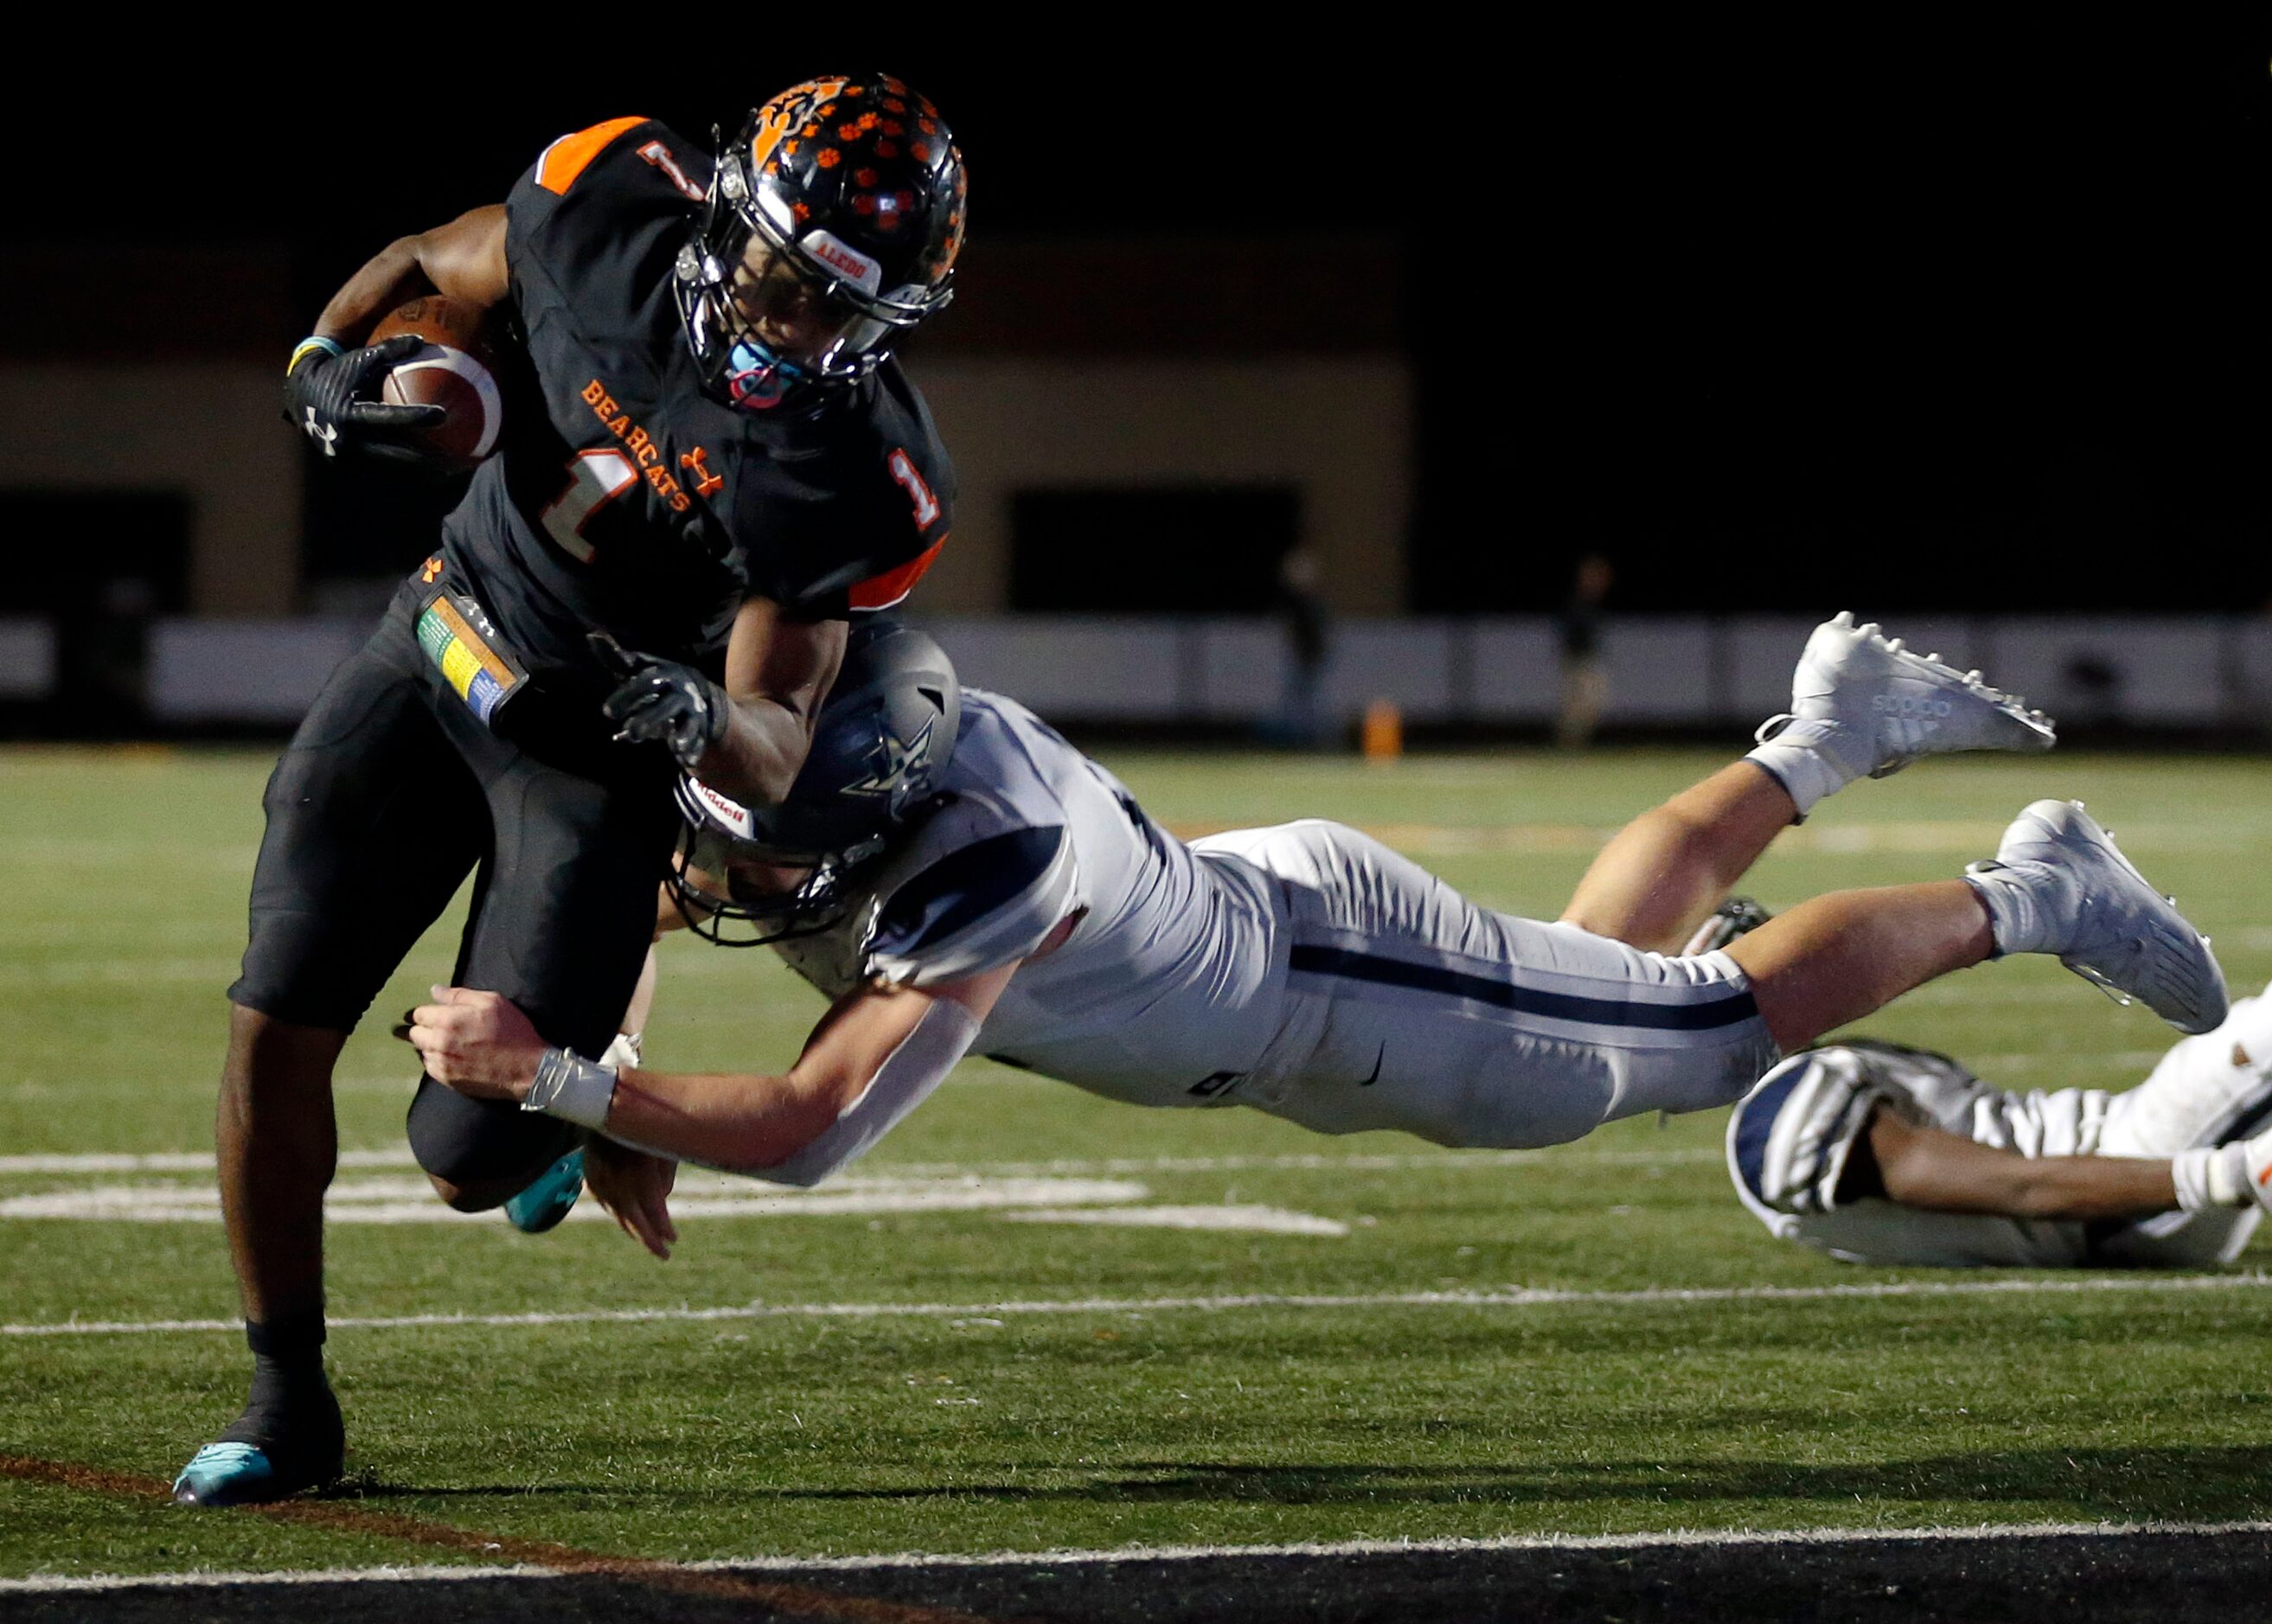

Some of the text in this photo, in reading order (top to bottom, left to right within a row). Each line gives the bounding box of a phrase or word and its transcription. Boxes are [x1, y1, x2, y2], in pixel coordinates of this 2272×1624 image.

[816, 243, 868, 278] ALEDO
[580, 379, 691, 512] BEARCATS
[887, 447, 941, 531] 1
[540, 448, 640, 564] 1
